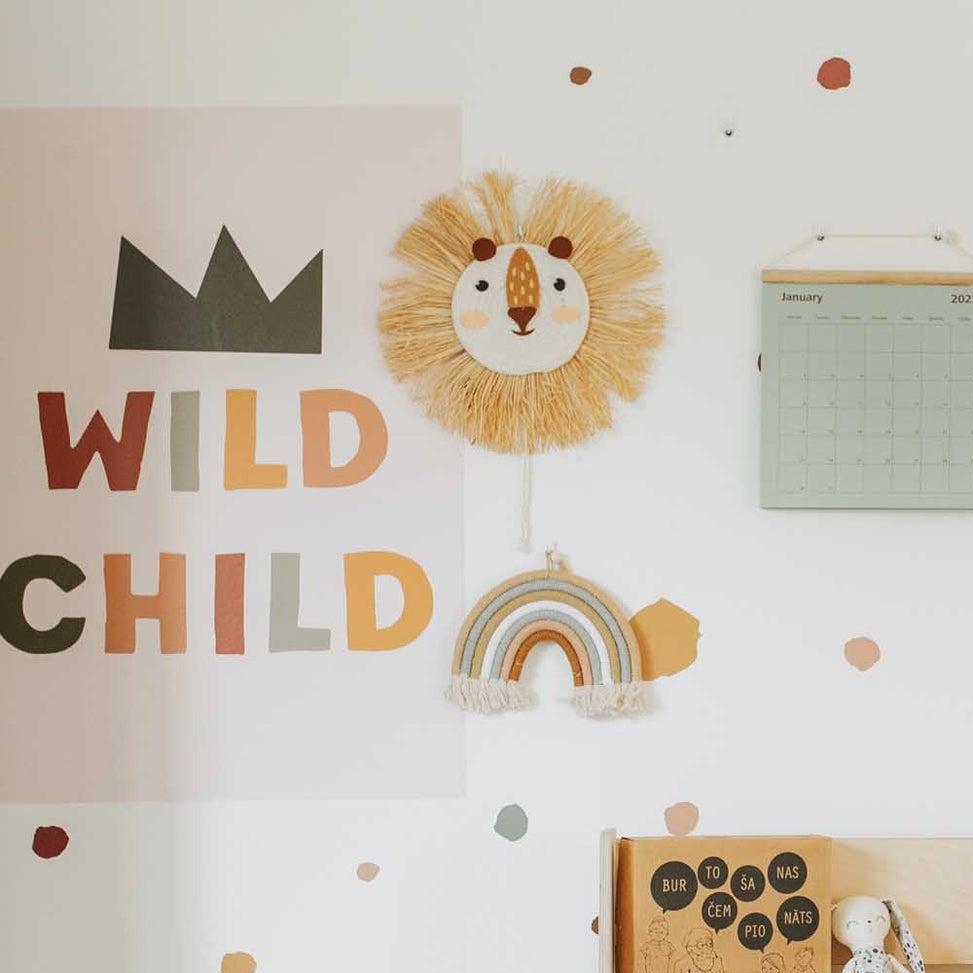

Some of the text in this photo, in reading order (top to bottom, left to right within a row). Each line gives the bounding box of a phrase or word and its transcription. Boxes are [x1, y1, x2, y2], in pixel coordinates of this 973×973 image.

[781, 291, 824, 305] January
[38, 389, 389, 492] WILD
[0, 550, 434, 655] CHILD
[705, 866, 720, 879] TO
[776, 866, 799, 879] NAS
[662, 878, 687, 892] BUR
[740, 873, 756, 890] ŠA
[707, 901, 731, 918] ČEM
[784, 910, 813, 924] NĀTS
[745, 924, 766, 938] PIO
